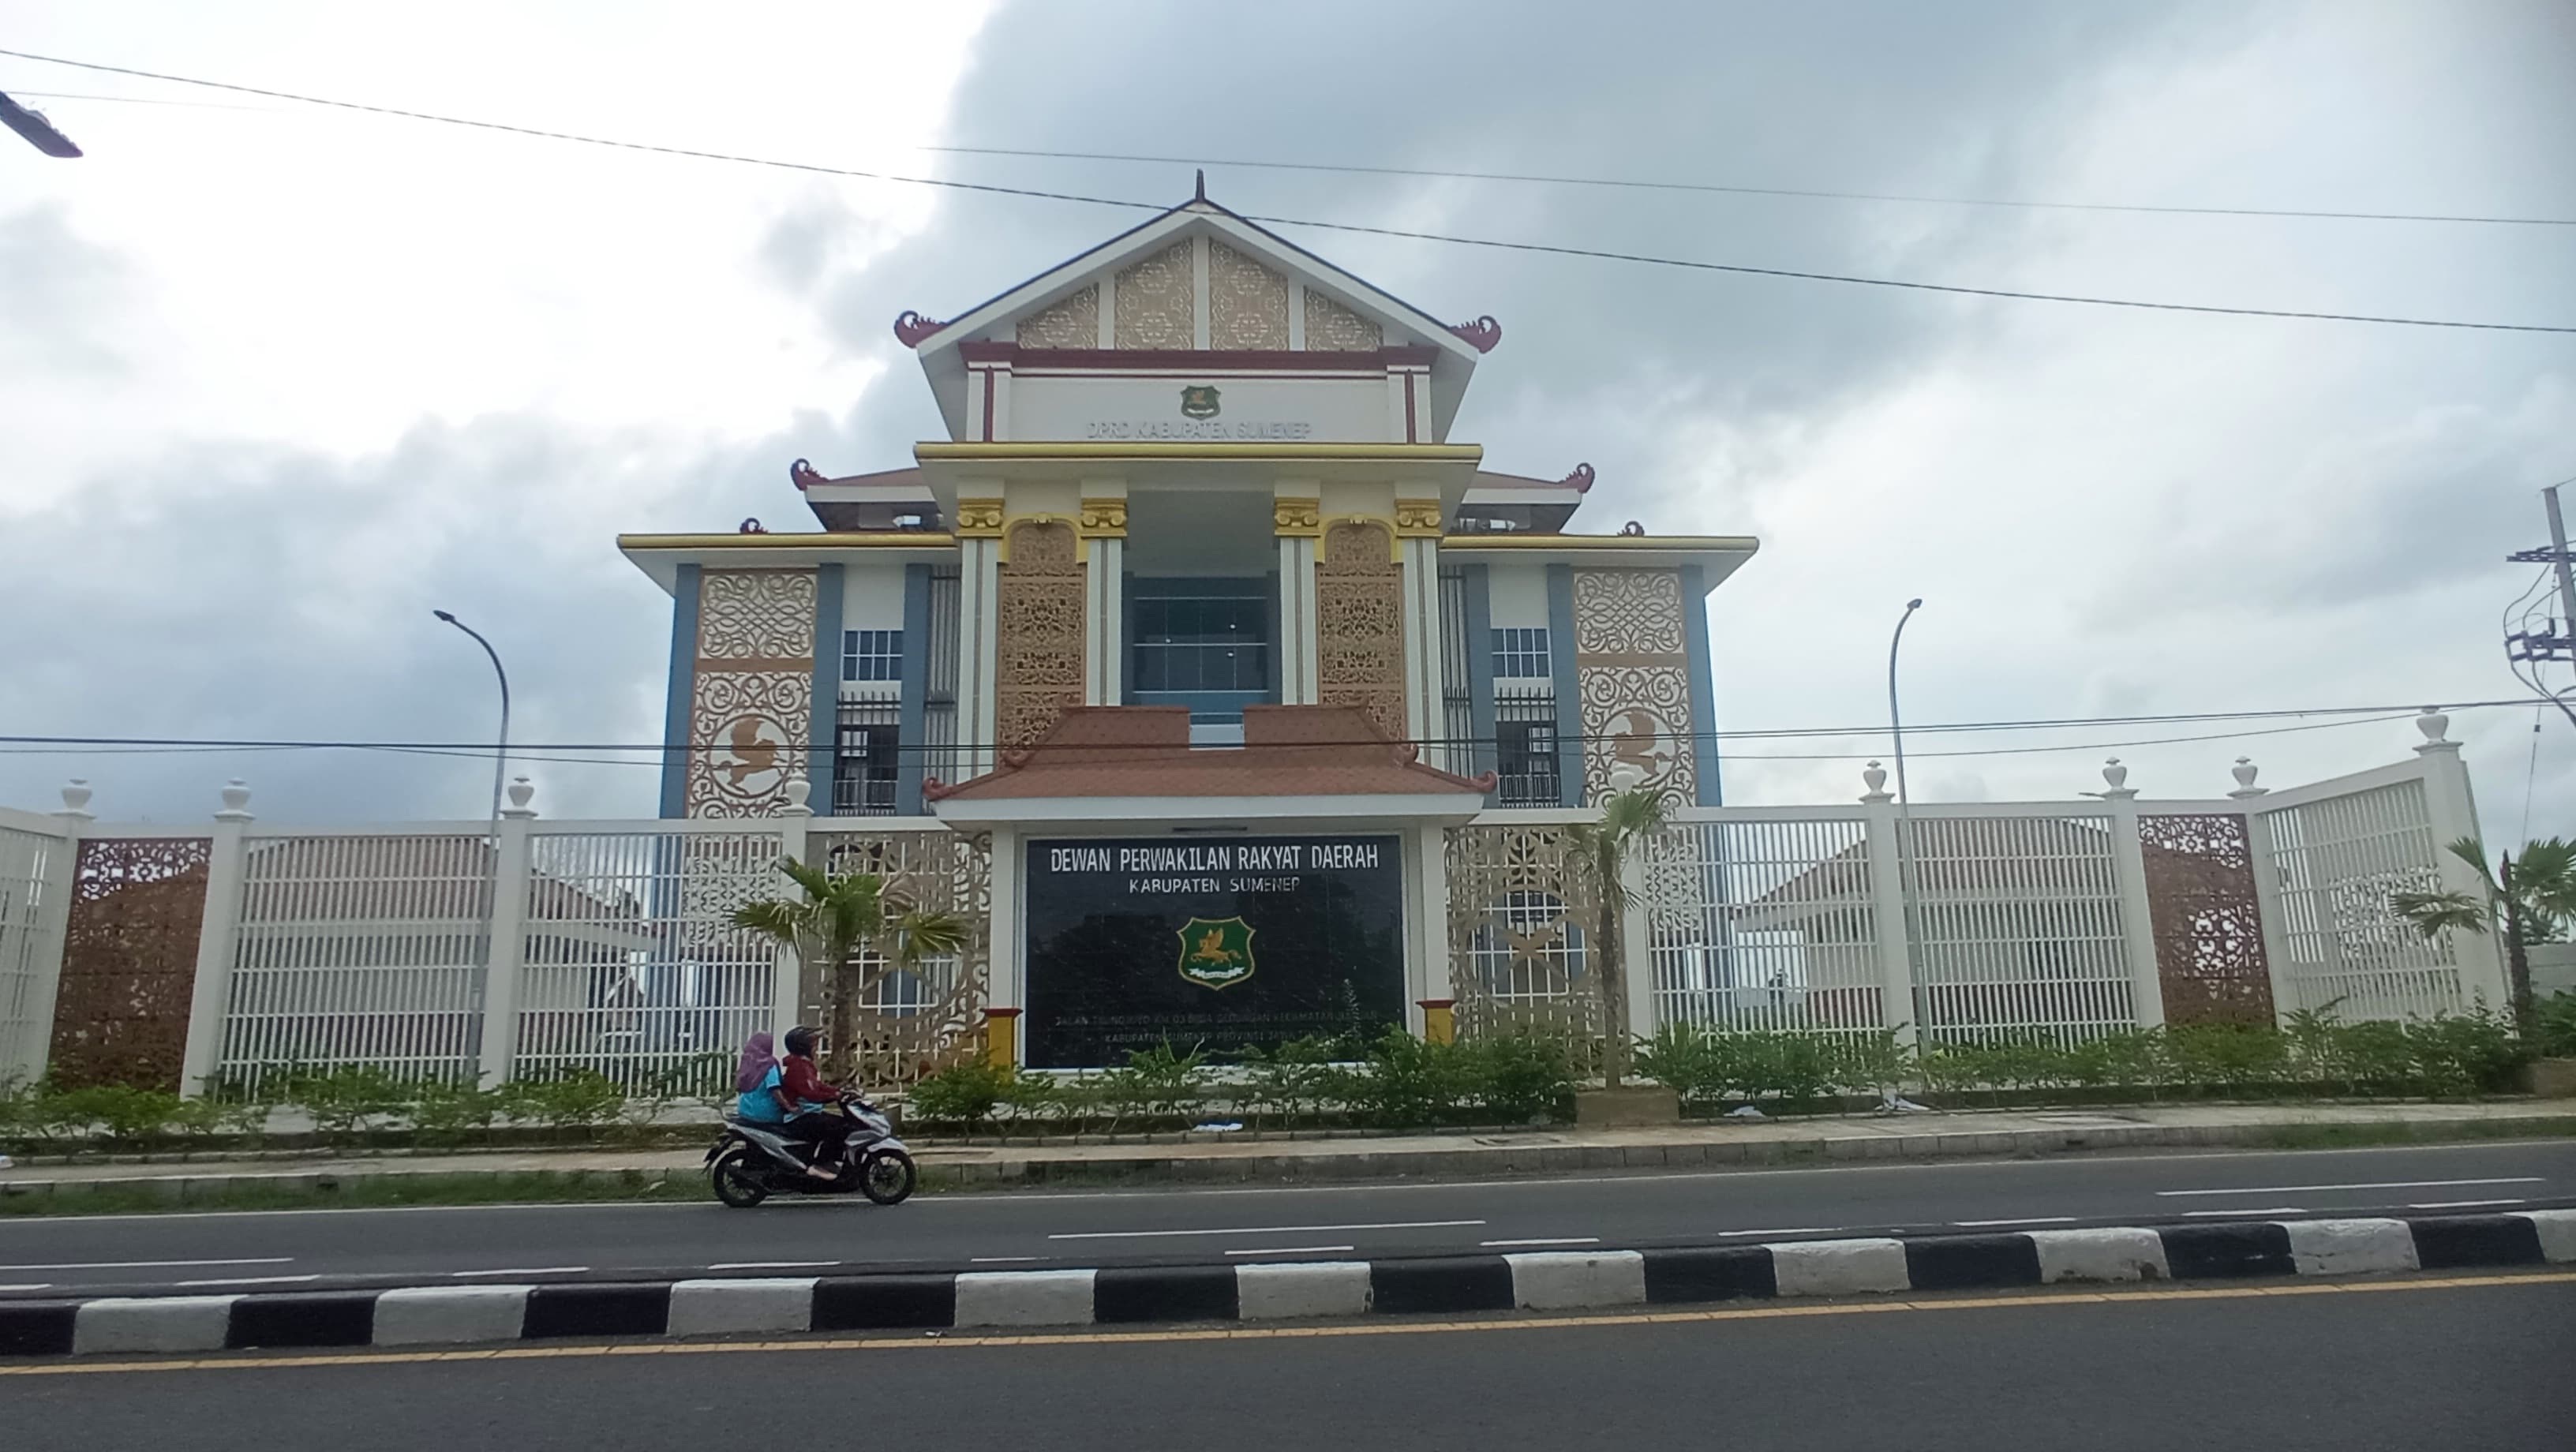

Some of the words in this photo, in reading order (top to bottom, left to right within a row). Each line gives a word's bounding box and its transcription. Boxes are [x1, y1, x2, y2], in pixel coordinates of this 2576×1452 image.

[1136, 422, 1231, 439] KABUPATEN
[1237, 421, 1311, 439] SUMENEP
[1050, 847, 1111, 872] DEWAN
[1119, 846, 1230, 872] PERWAKILAN
[1237, 845, 1301, 870] RAKYAT
[1311, 844, 1379, 870] DAERAH
[1129, 878, 1221, 894] KABUPATEN
[1230, 877, 1301, 893] SUMENEP
